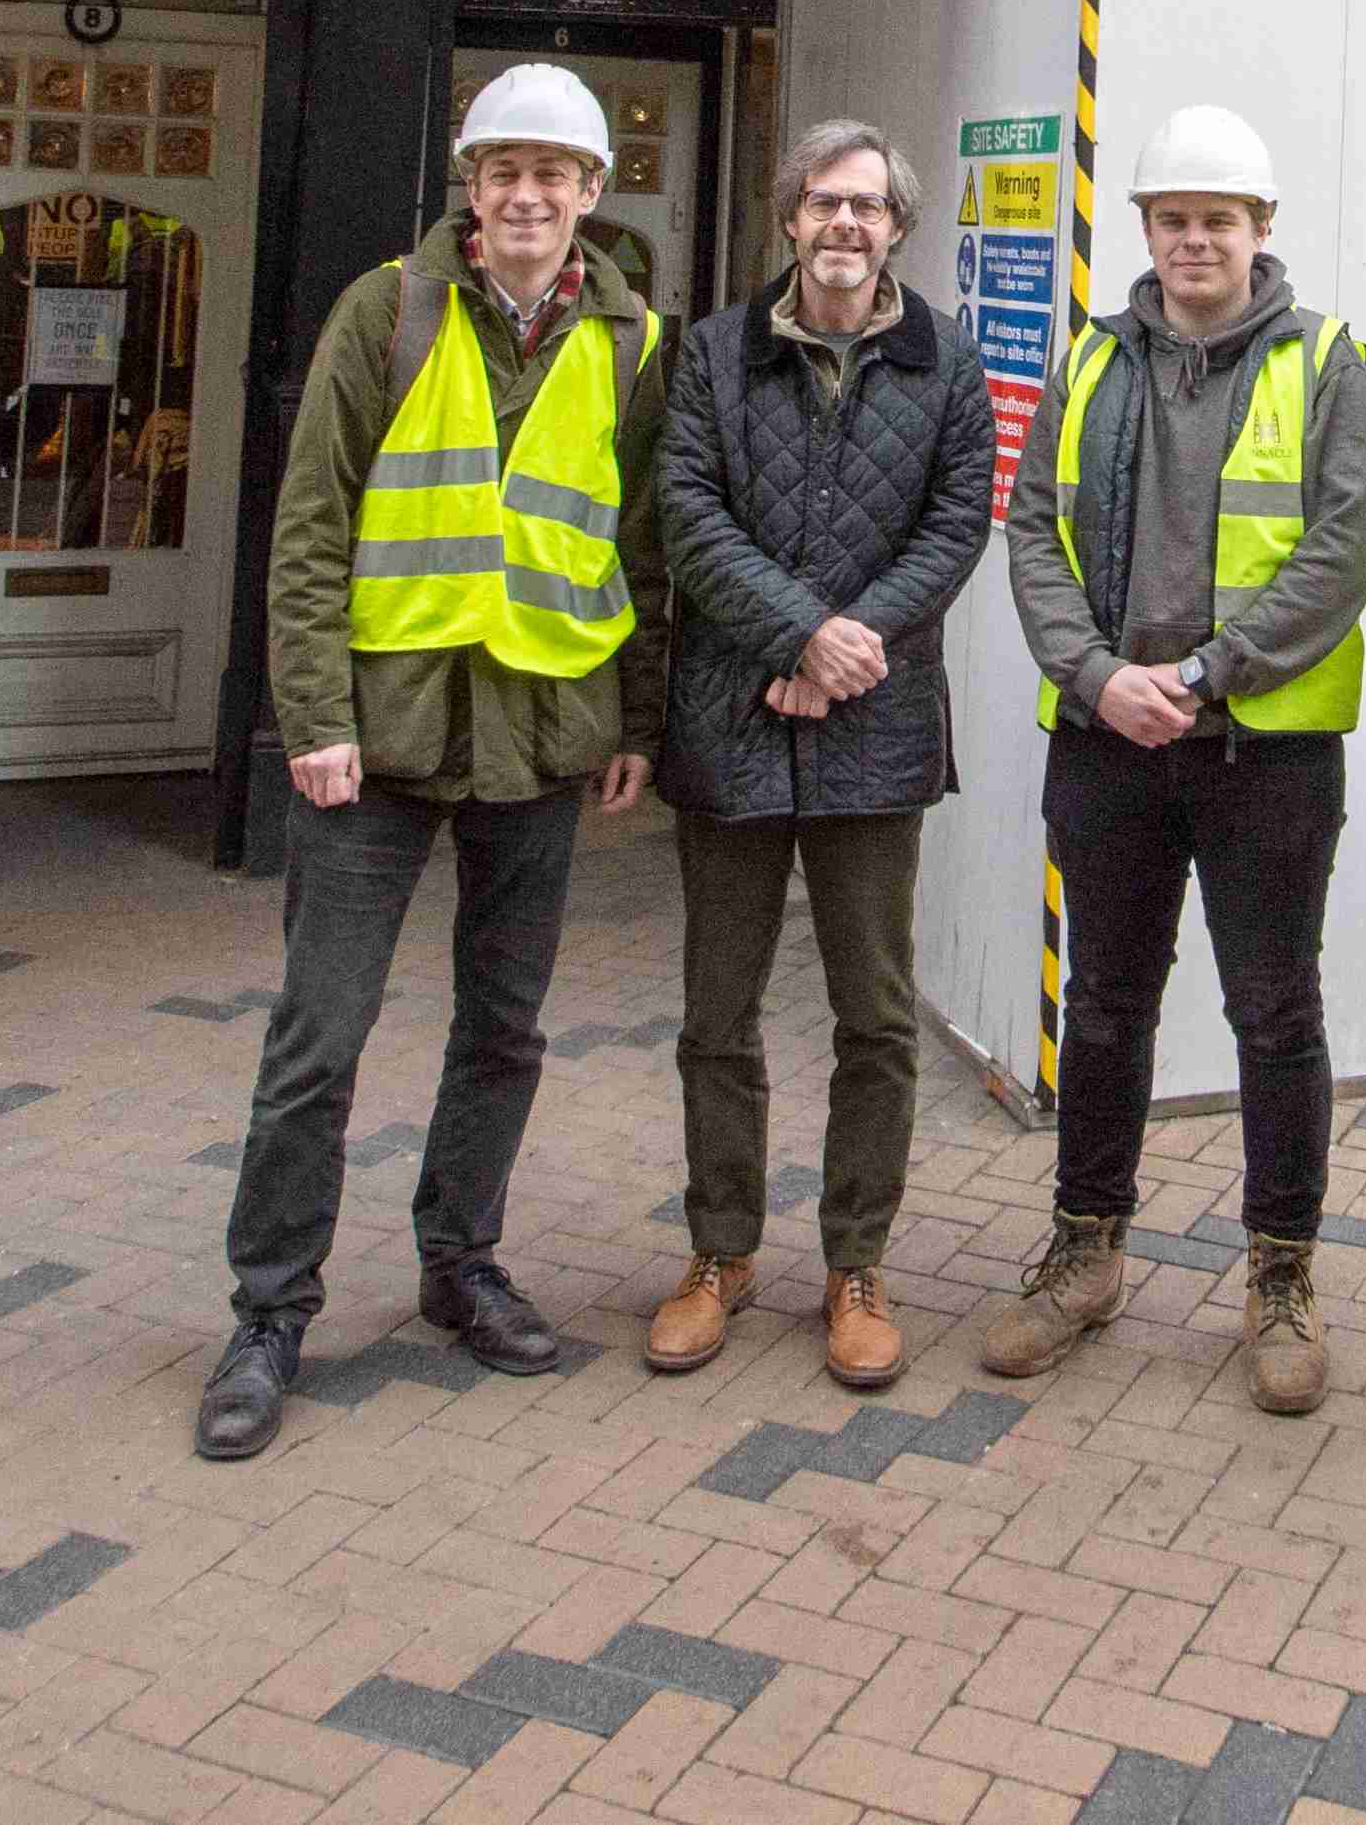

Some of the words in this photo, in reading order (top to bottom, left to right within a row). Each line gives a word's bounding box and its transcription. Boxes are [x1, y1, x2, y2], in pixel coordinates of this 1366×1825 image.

[85, 7, 100, 27] 8
[555, 26, 569, 47] 6
[971, 125, 993, 151] SITE
[994, 122, 1044, 151] SAFETY
[995, 170, 1041, 201] Warning
[31, 192, 99, 225] NO
